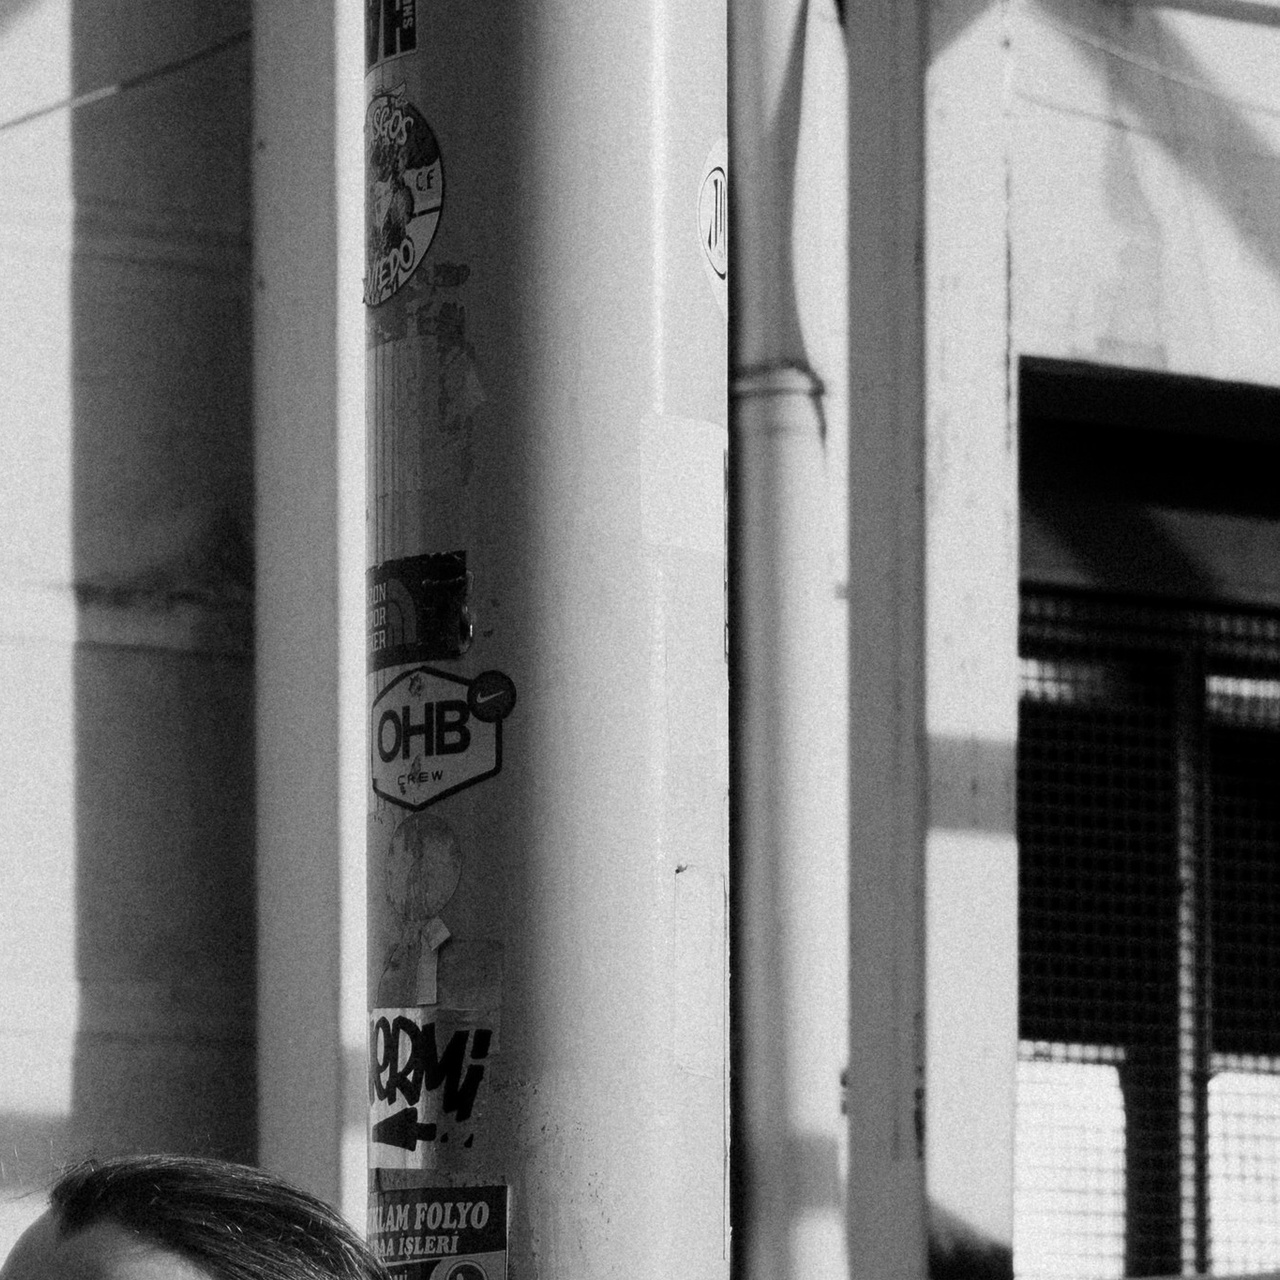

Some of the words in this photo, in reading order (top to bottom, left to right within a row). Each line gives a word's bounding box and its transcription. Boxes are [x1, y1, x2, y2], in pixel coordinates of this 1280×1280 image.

[377, 700, 471, 763] OHB
[397, 770, 444, 787] CREW
[414, 1201, 490, 1230] FOLYO
[399, 1231, 460, 1260] İŞLERİ
